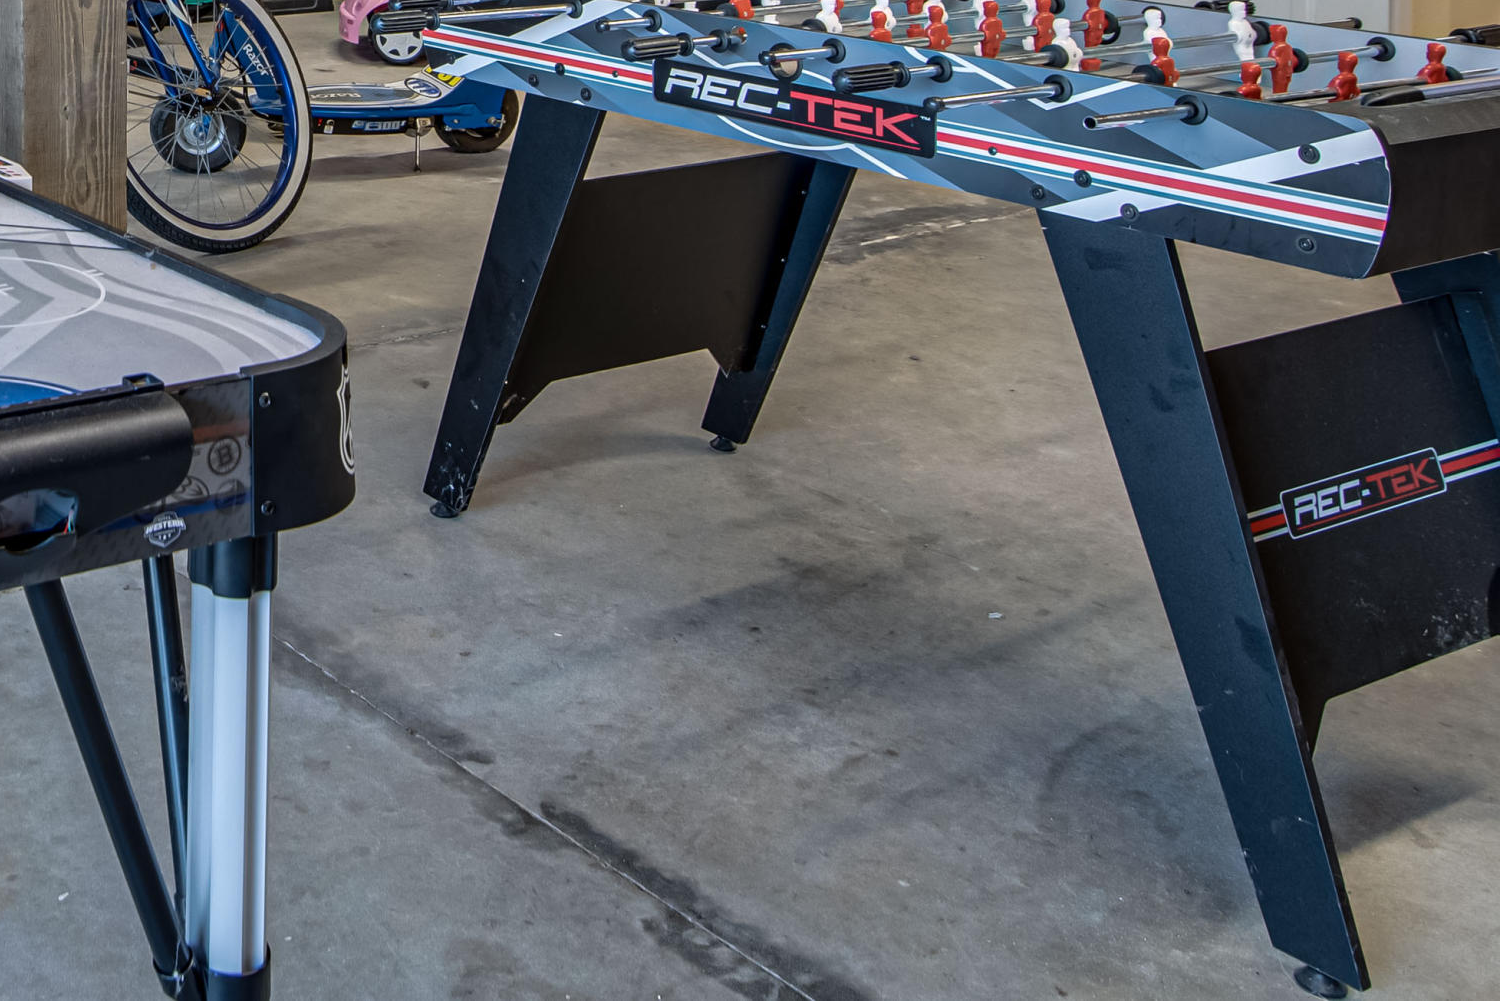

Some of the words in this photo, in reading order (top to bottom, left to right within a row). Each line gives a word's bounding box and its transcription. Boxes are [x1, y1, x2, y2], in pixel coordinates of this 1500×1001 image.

[243, 43, 270, 76] Razor
[664, 68, 920, 145] REC-TEK
[1293, 457, 1437, 526] REC-TEK
[146, 518, 186, 535] WESTERN
